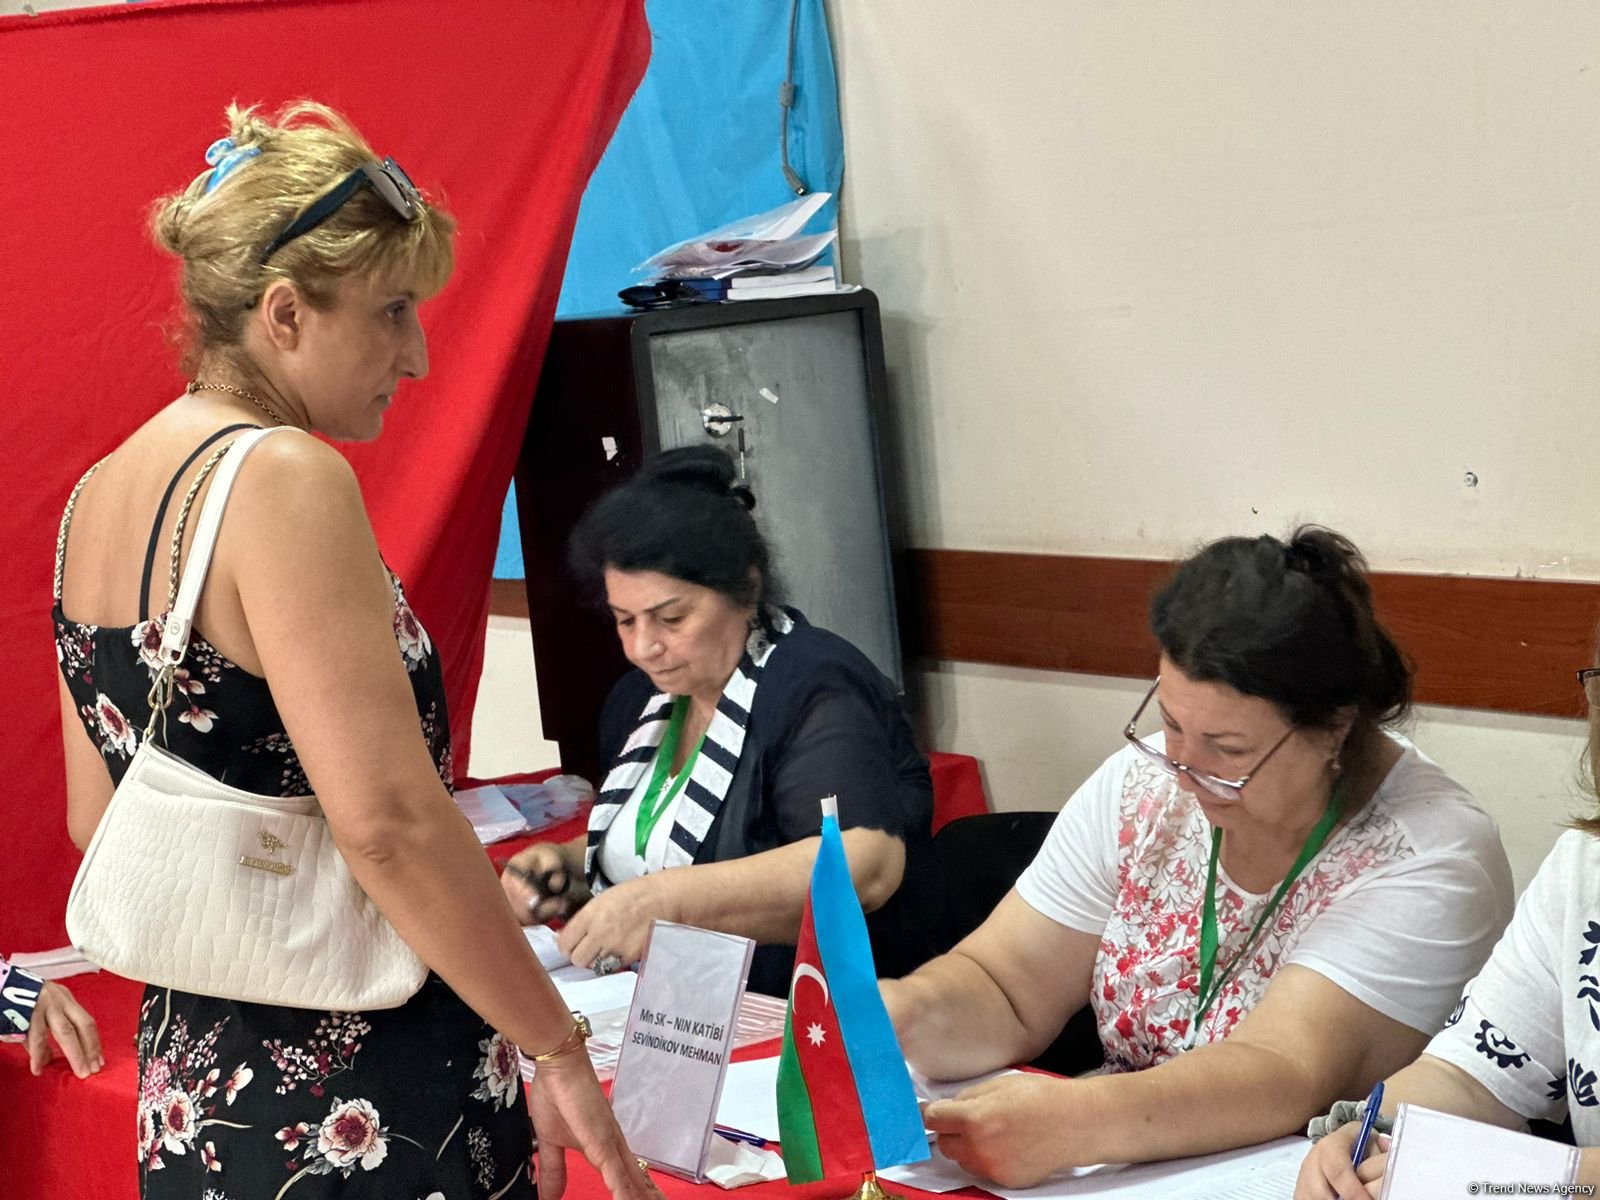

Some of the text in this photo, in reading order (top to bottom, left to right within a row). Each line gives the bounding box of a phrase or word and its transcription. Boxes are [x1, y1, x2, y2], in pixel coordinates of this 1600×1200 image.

[654, 1013, 666, 1027] SK
[673, 1017, 692, 1033] NIN
[692, 1021, 725, 1041] KATİBİ
[632, 1031, 722, 1066] SEVİNDİKOV MEHMAN
